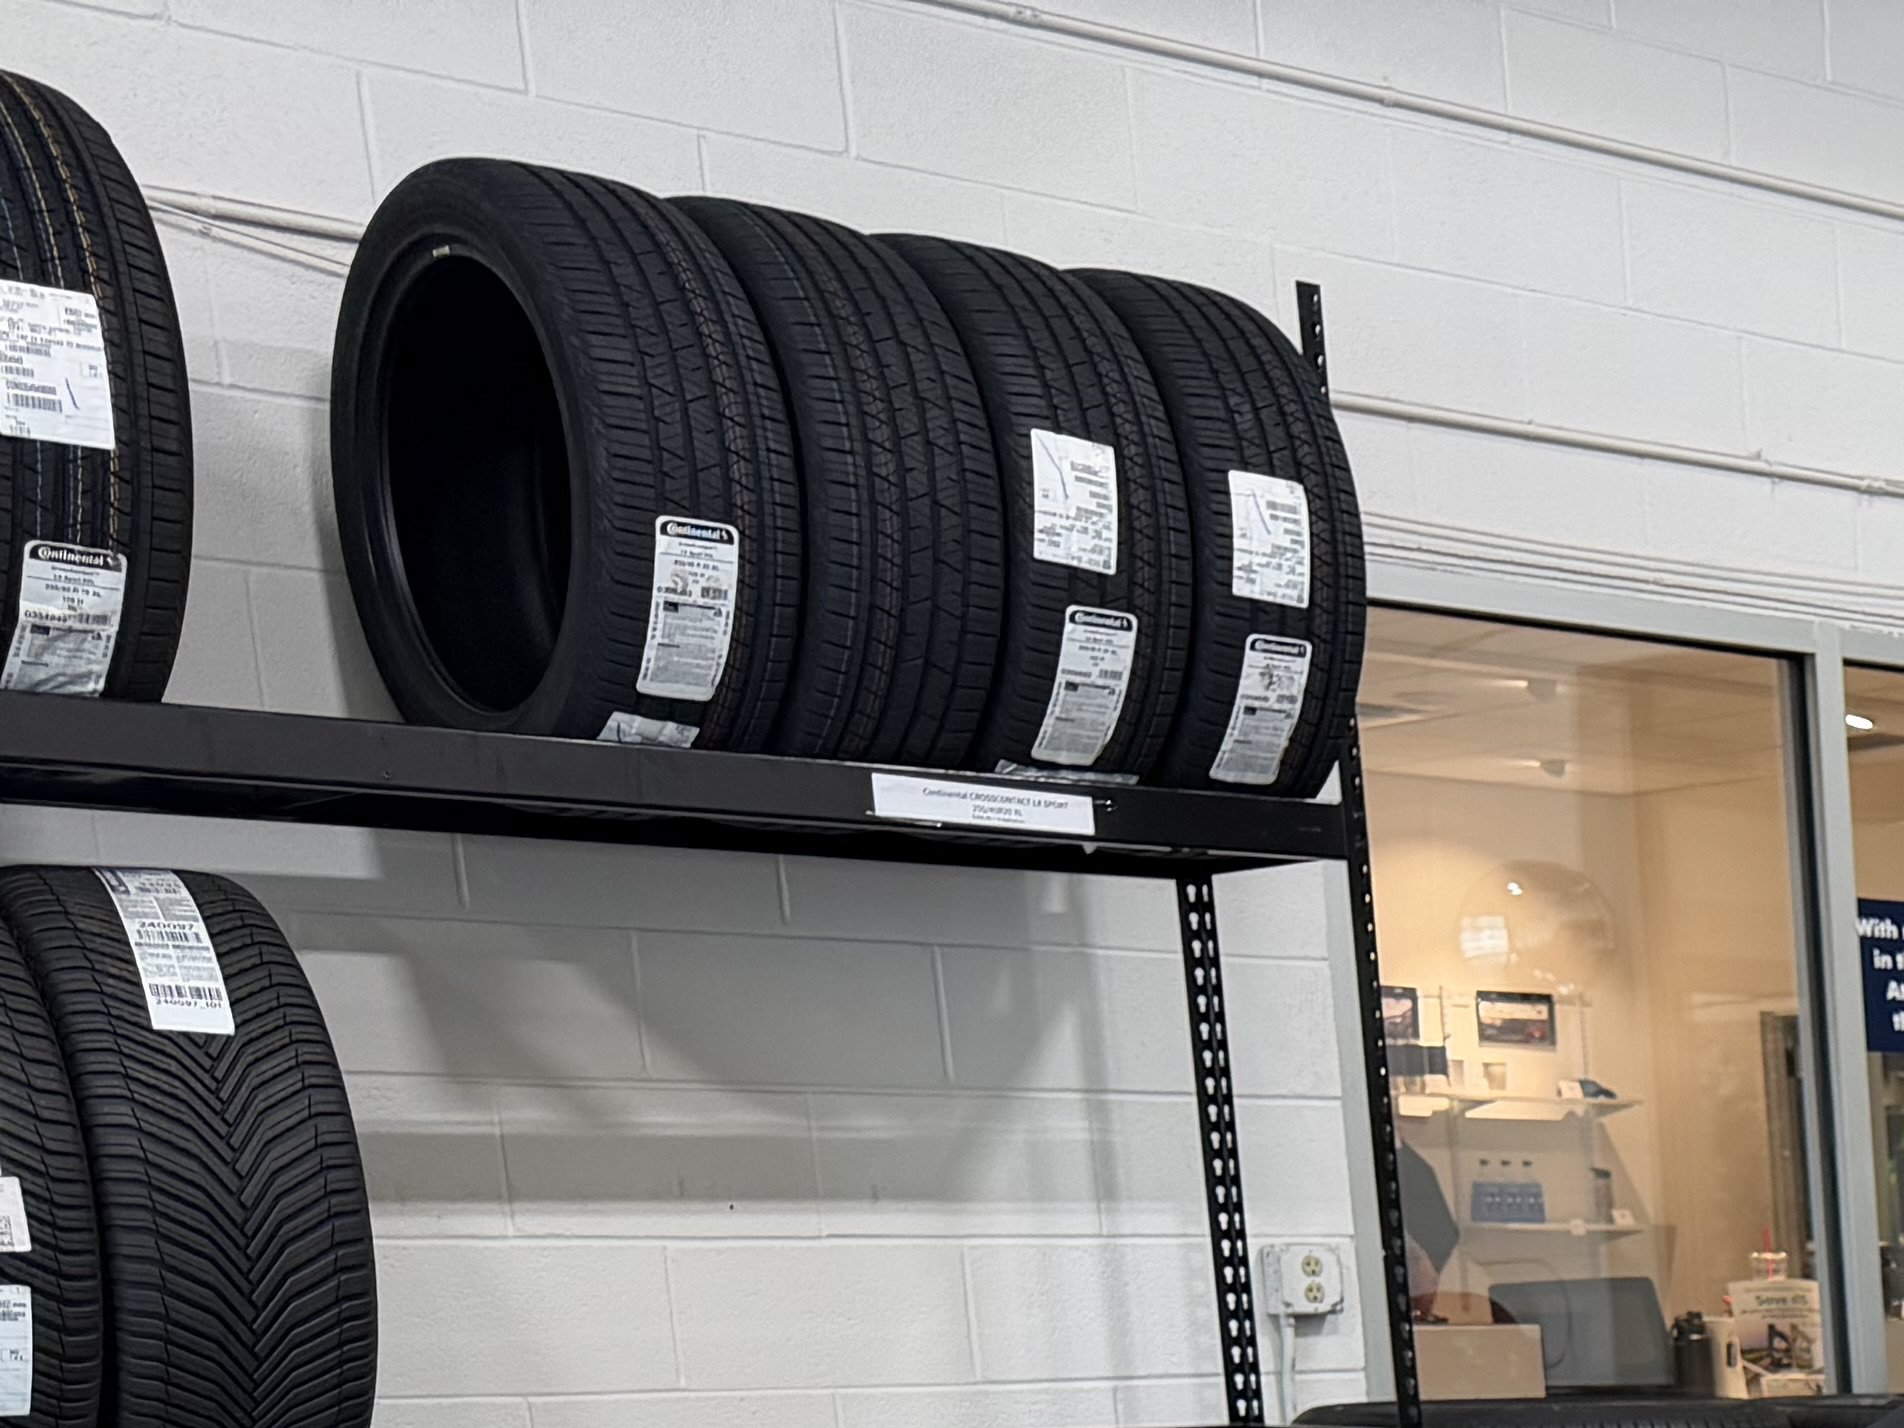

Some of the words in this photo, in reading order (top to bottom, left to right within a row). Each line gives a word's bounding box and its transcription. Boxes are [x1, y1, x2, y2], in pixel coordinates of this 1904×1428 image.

[667, 522, 720, 540] Continental
[38, 546, 104, 565] Continental
[922, 787, 968, 799] Continental
[1855, 916, 1898, 939] With
[1873, 949, 1893, 969] in
